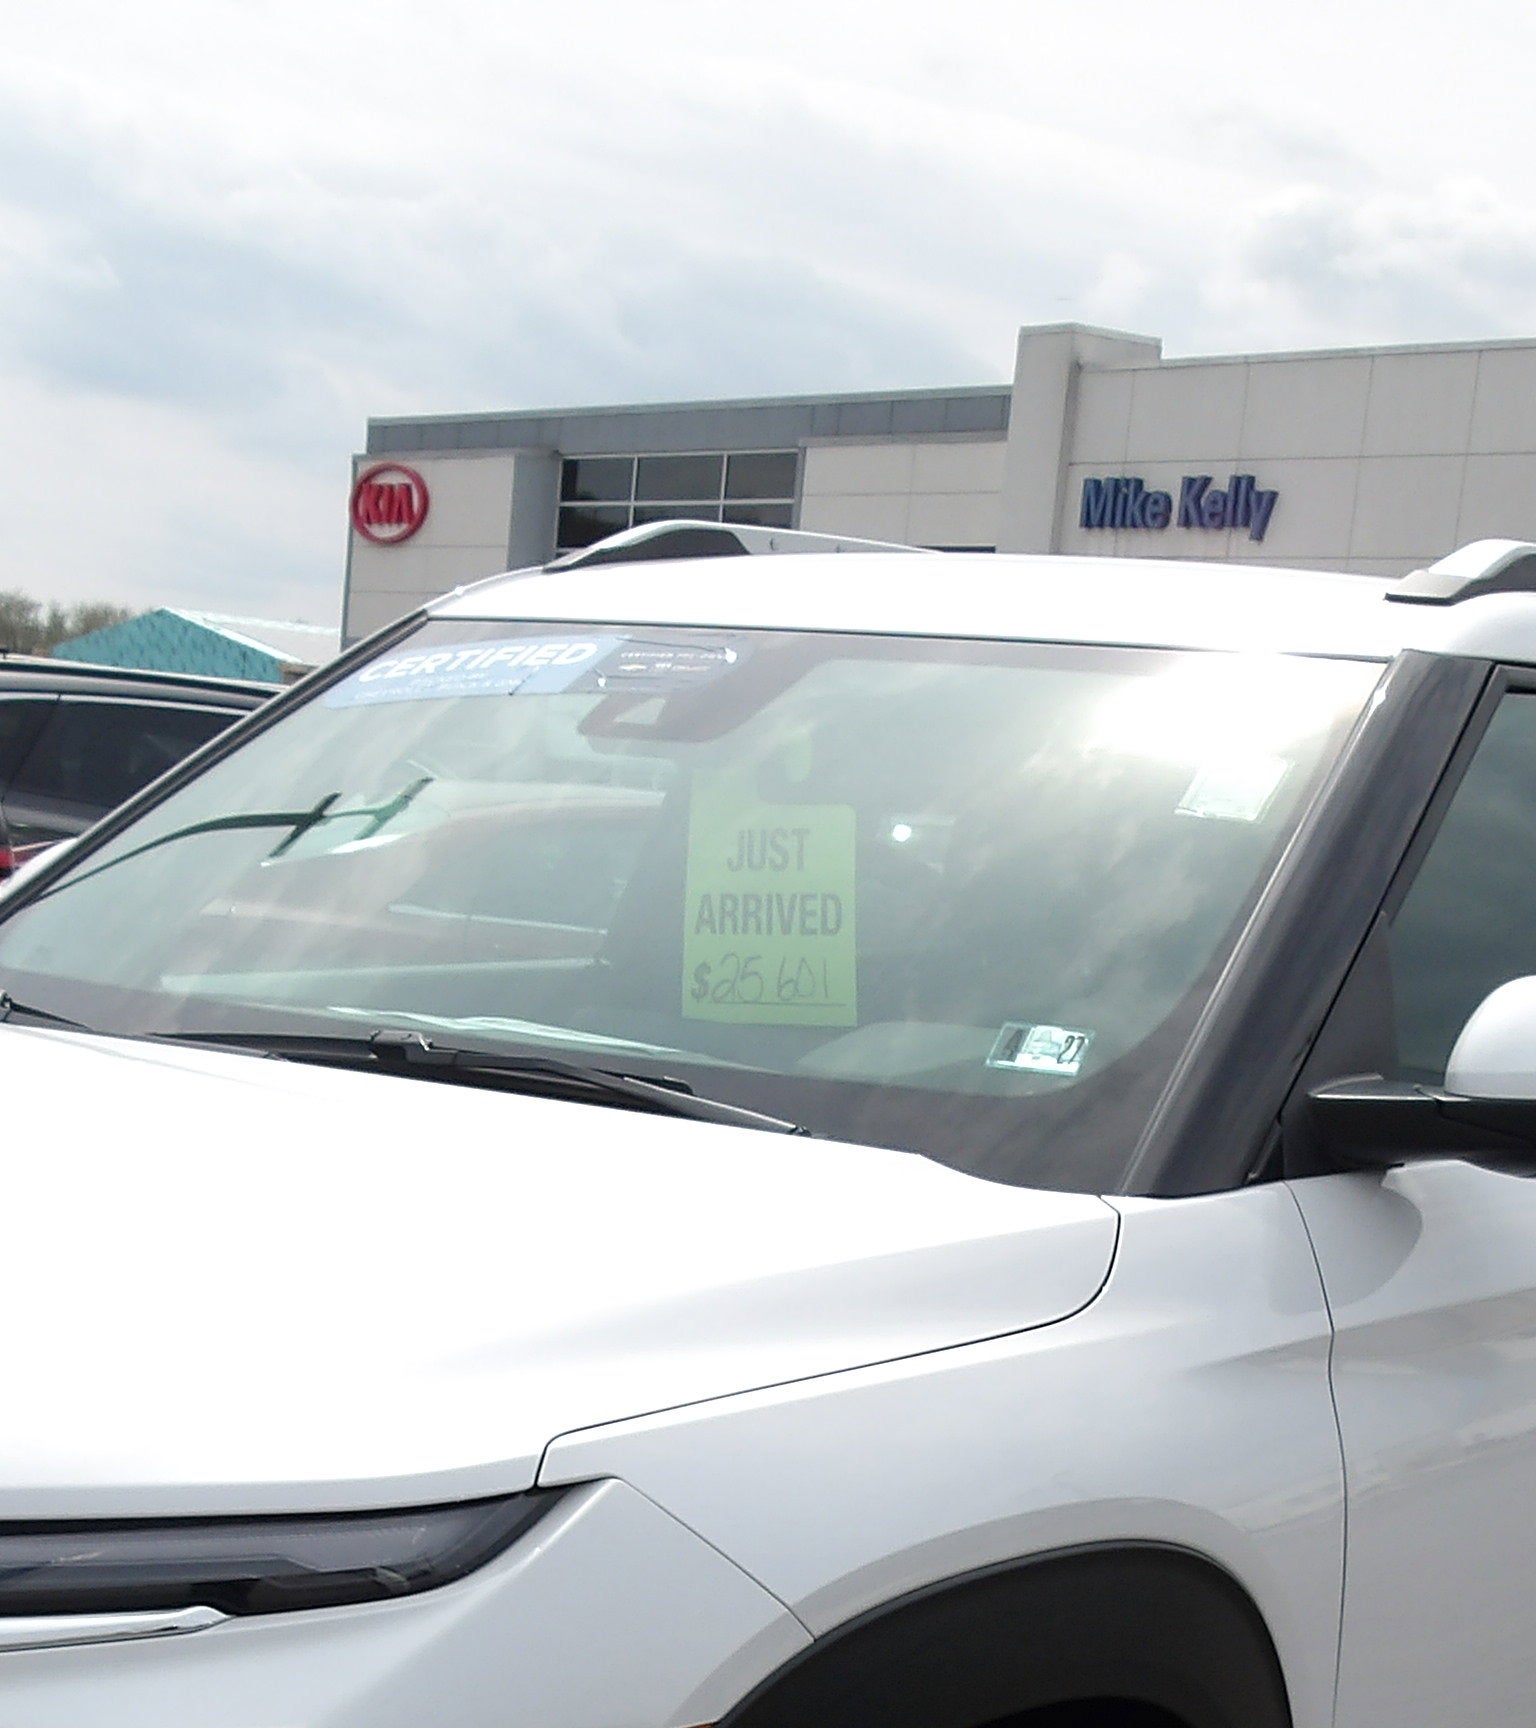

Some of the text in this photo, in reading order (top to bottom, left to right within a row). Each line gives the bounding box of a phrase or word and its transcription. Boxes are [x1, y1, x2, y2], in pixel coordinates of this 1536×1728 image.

[364, 482, 412, 526] KIA
[1079, 475, 1279, 541] Mike Kelly
[358, 642, 598, 683] CERTIFIED
[726, 828, 810, 872] JUST
[694, 892, 843, 936] ARRIVED
